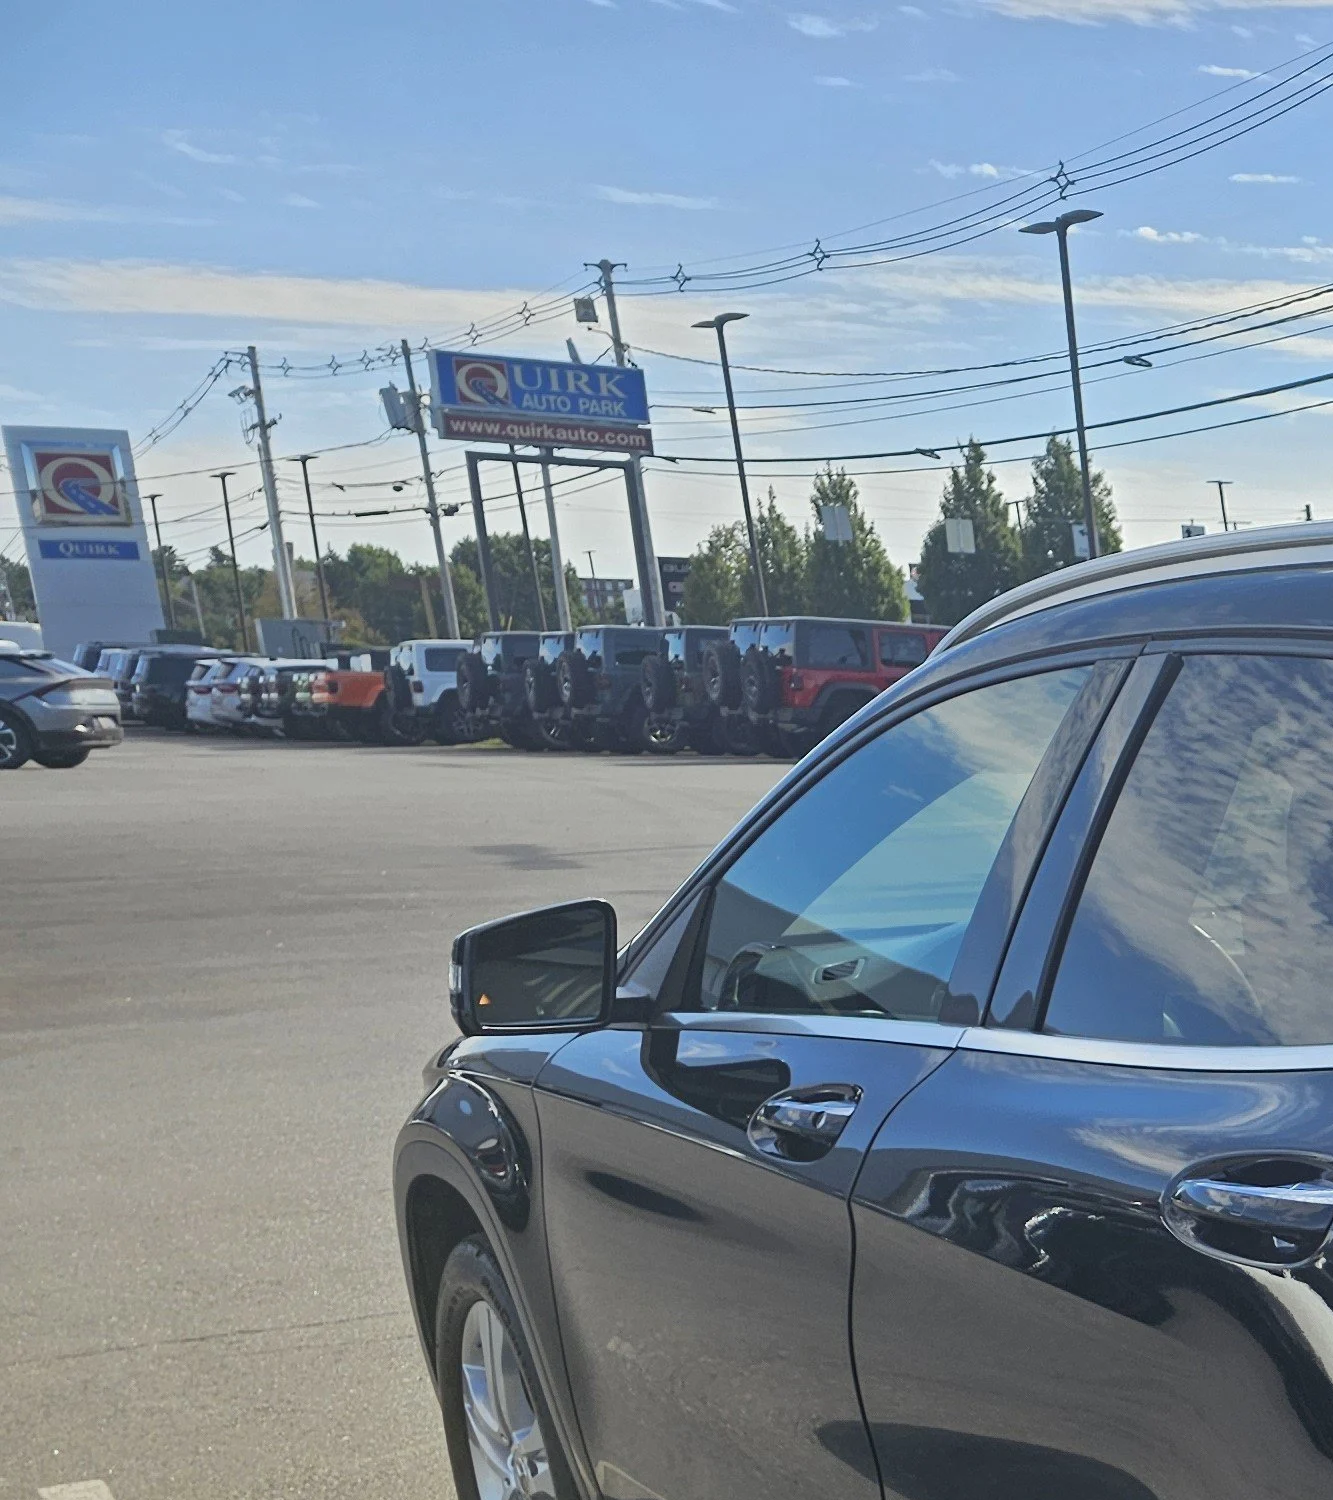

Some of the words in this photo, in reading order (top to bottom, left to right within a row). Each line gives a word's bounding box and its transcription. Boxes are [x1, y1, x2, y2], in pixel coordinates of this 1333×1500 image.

[521, 392, 571, 412] AUTO
[579, 397, 627, 417] PARK
[450, 419, 646, 447] www.quirkauto.com
